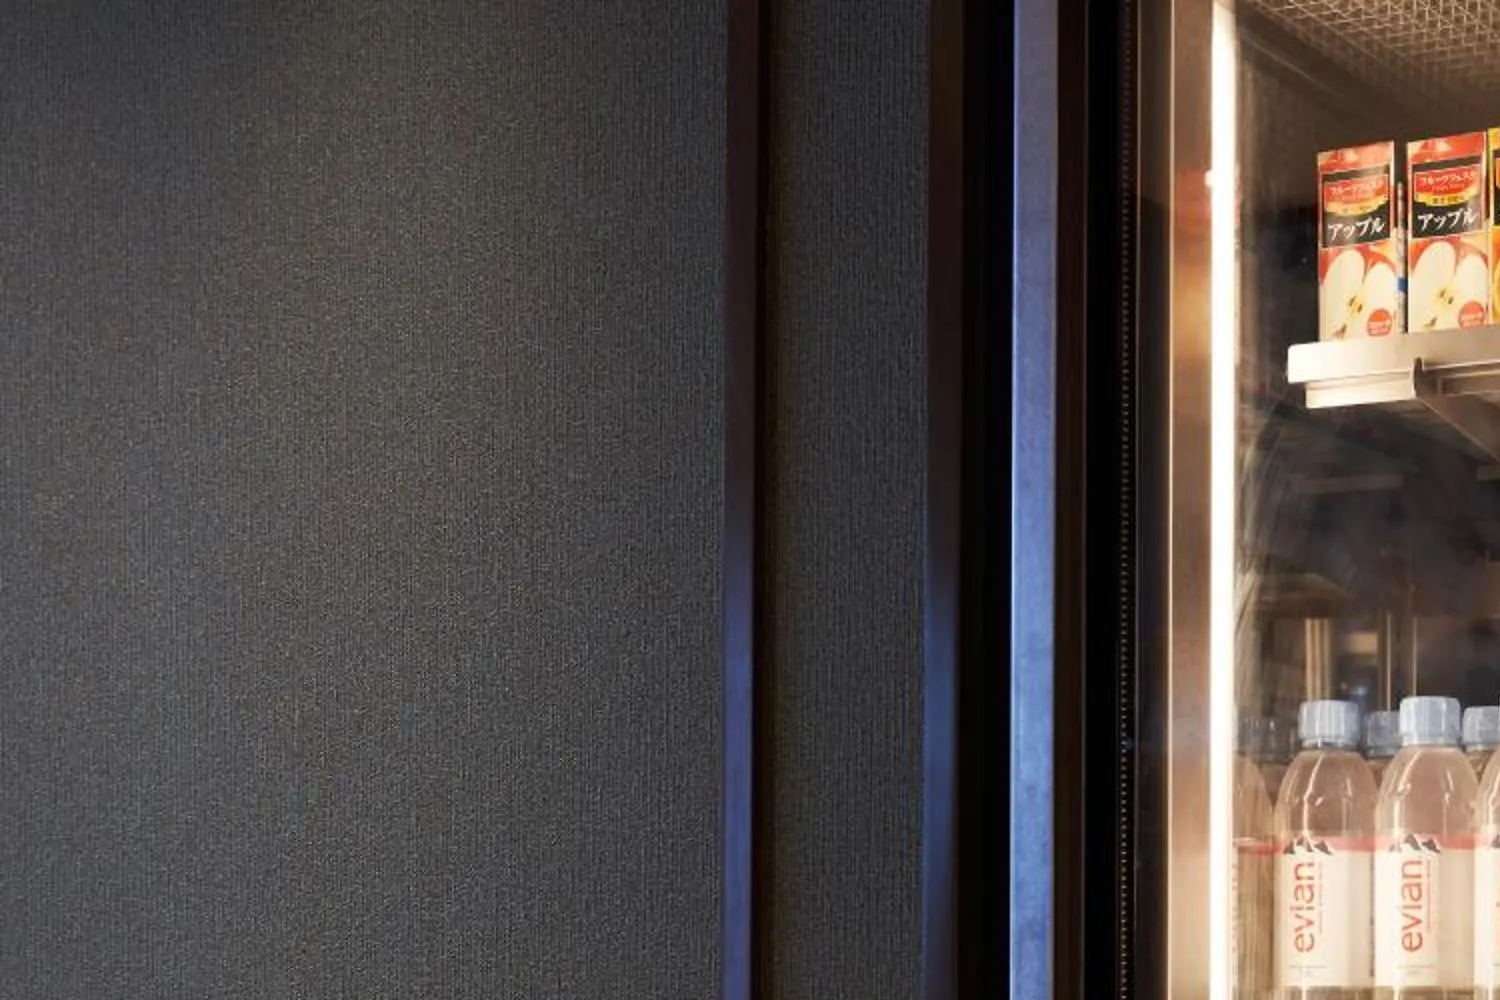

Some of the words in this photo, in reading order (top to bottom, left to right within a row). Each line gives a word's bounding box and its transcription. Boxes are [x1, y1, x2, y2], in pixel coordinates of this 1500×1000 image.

[1328, 216, 1385, 241] アップル
[1417, 207, 1478, 231] アップル
[1289, 860, 1316, 953] evian
[1397, 858, 1424, 953] evian
